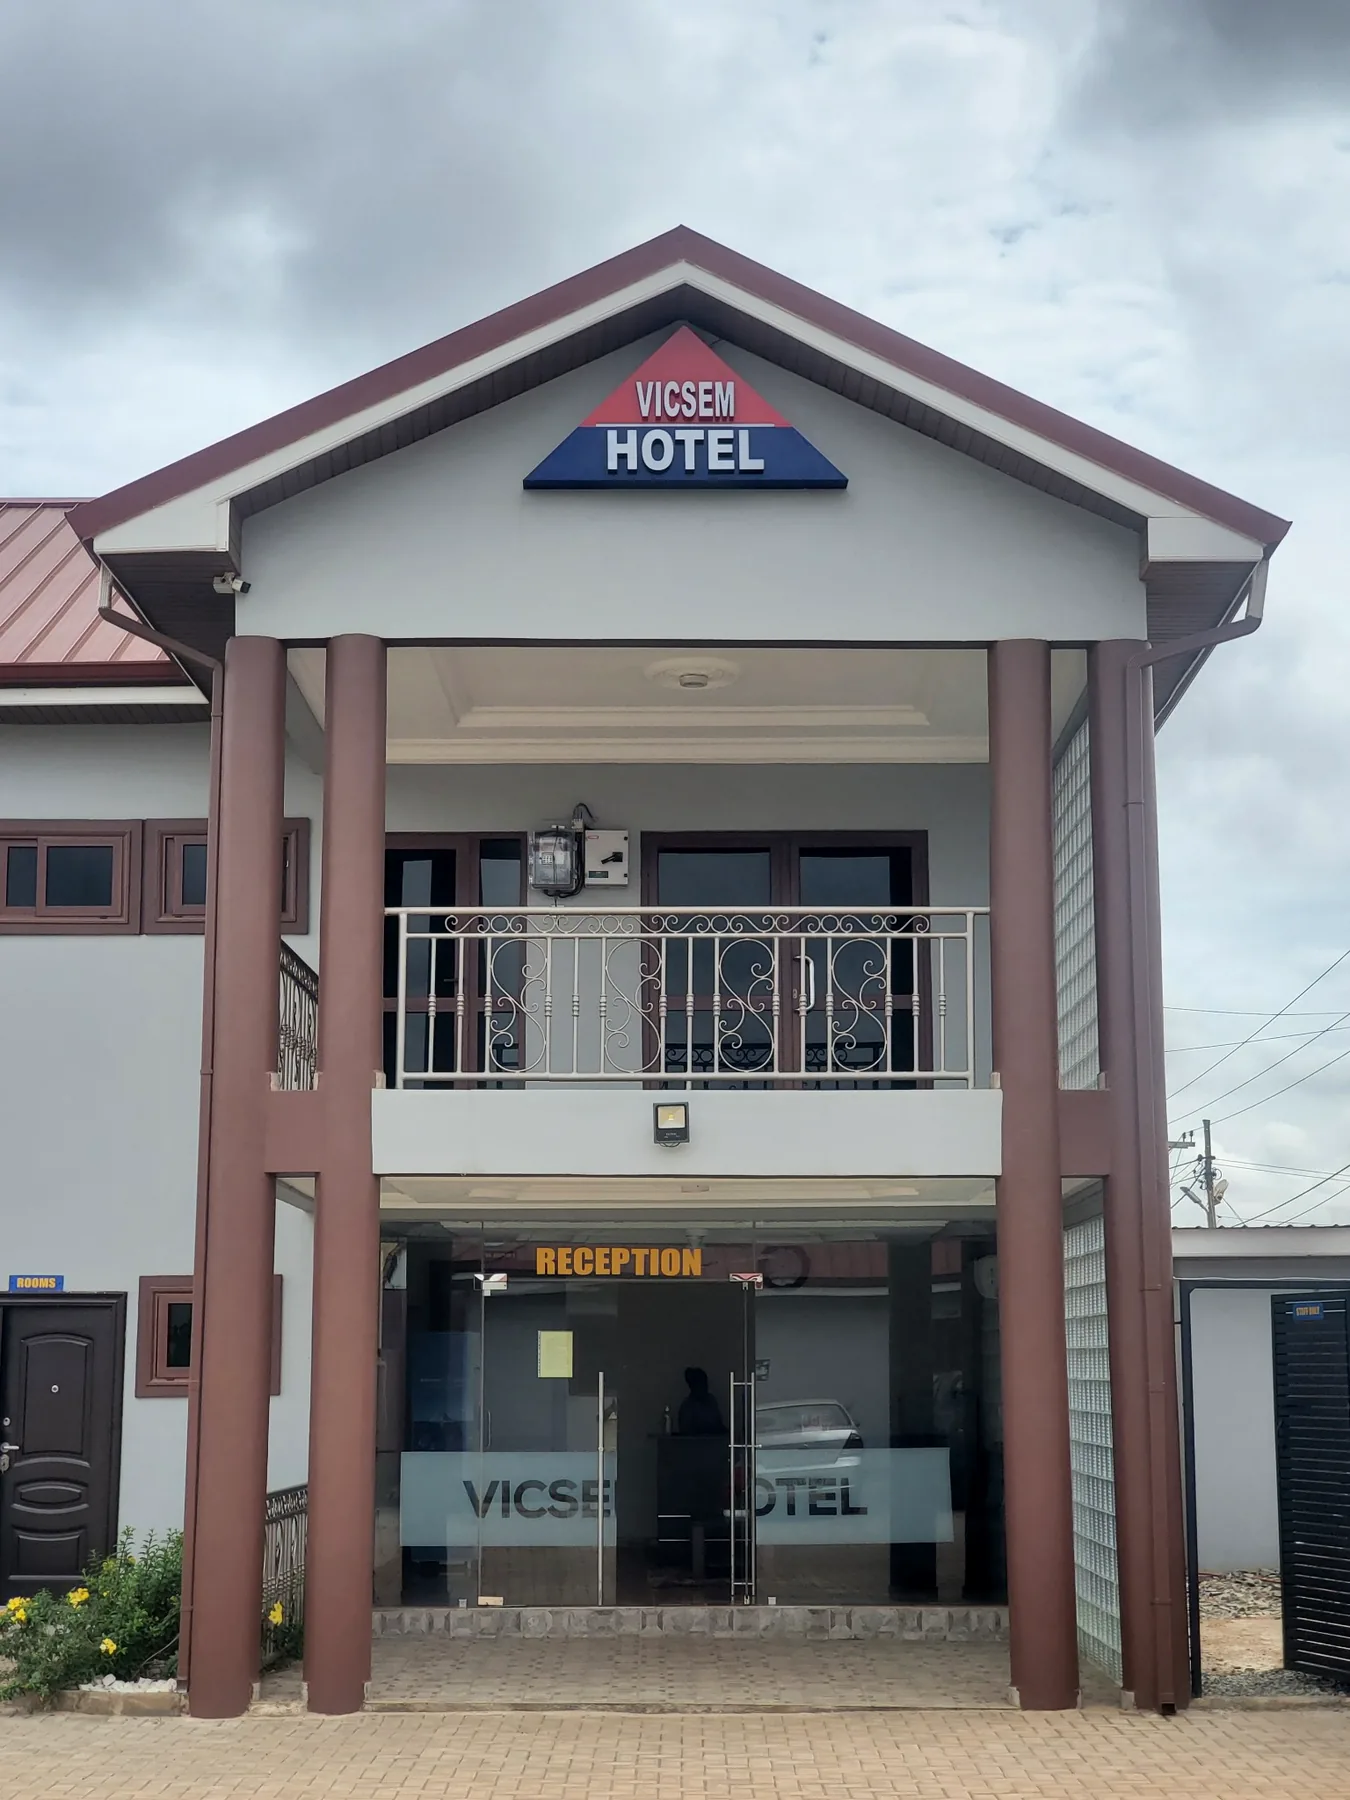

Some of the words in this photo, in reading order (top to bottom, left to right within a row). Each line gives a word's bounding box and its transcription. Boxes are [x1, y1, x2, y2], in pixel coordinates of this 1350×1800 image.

[636, 381, 735, 418] VICSEM
[607, 429, 765, 472] HOTEL
[536, 1247, 702, 1276] RECEPTION
[16, 1277, 56, 1289] ROOMS
[462, 1479, 616, 1519] VICSE
